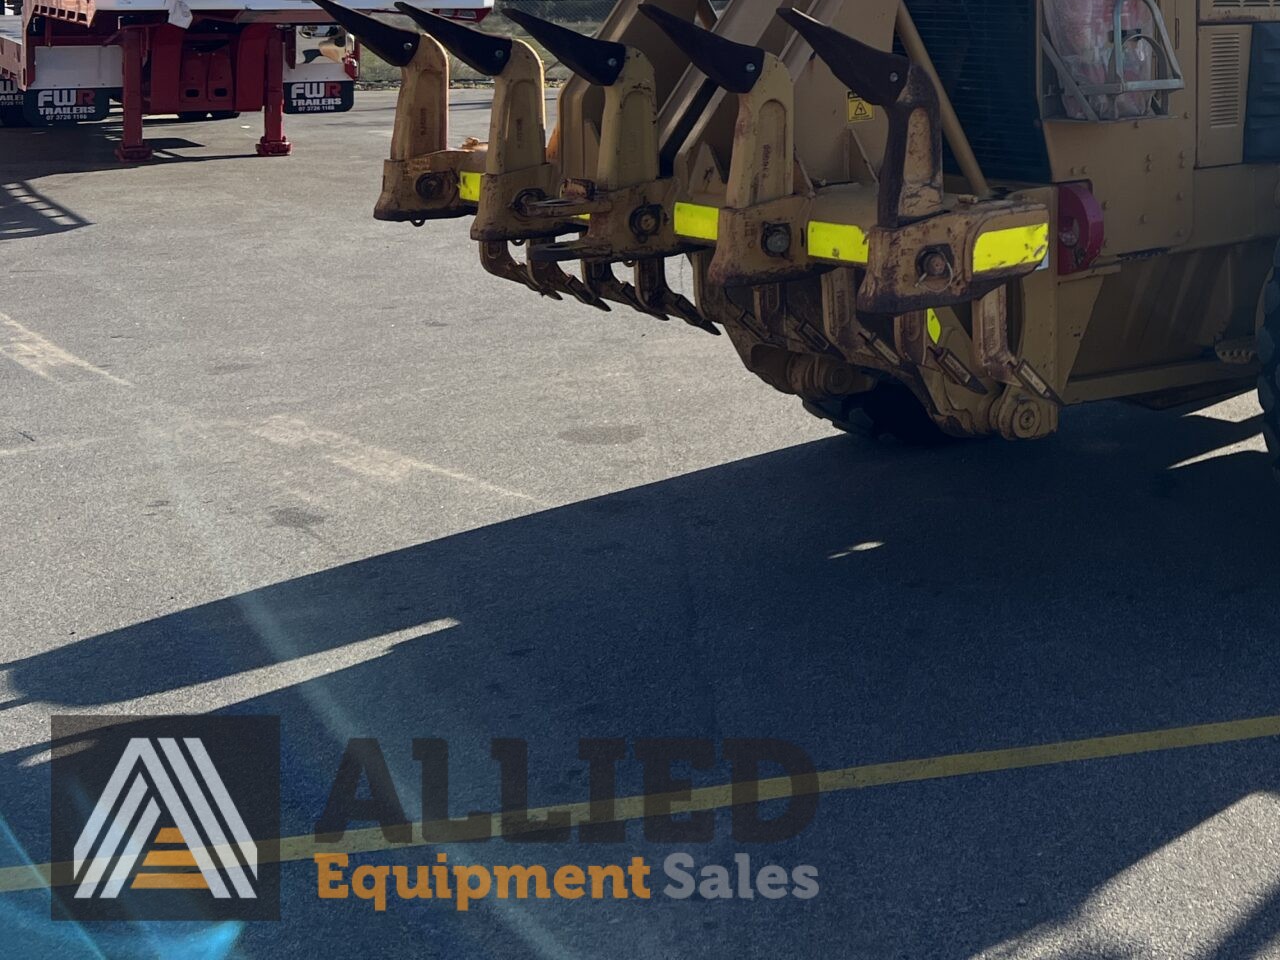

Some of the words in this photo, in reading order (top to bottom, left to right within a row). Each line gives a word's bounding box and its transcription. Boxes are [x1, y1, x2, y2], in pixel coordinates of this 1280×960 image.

[291, 82, 342, 99] FWR
[37, 89, 96, 107] FWR
[292, 98, 342, 106] TRAILERS
[39, 106, 96, 115] TRAILERS
